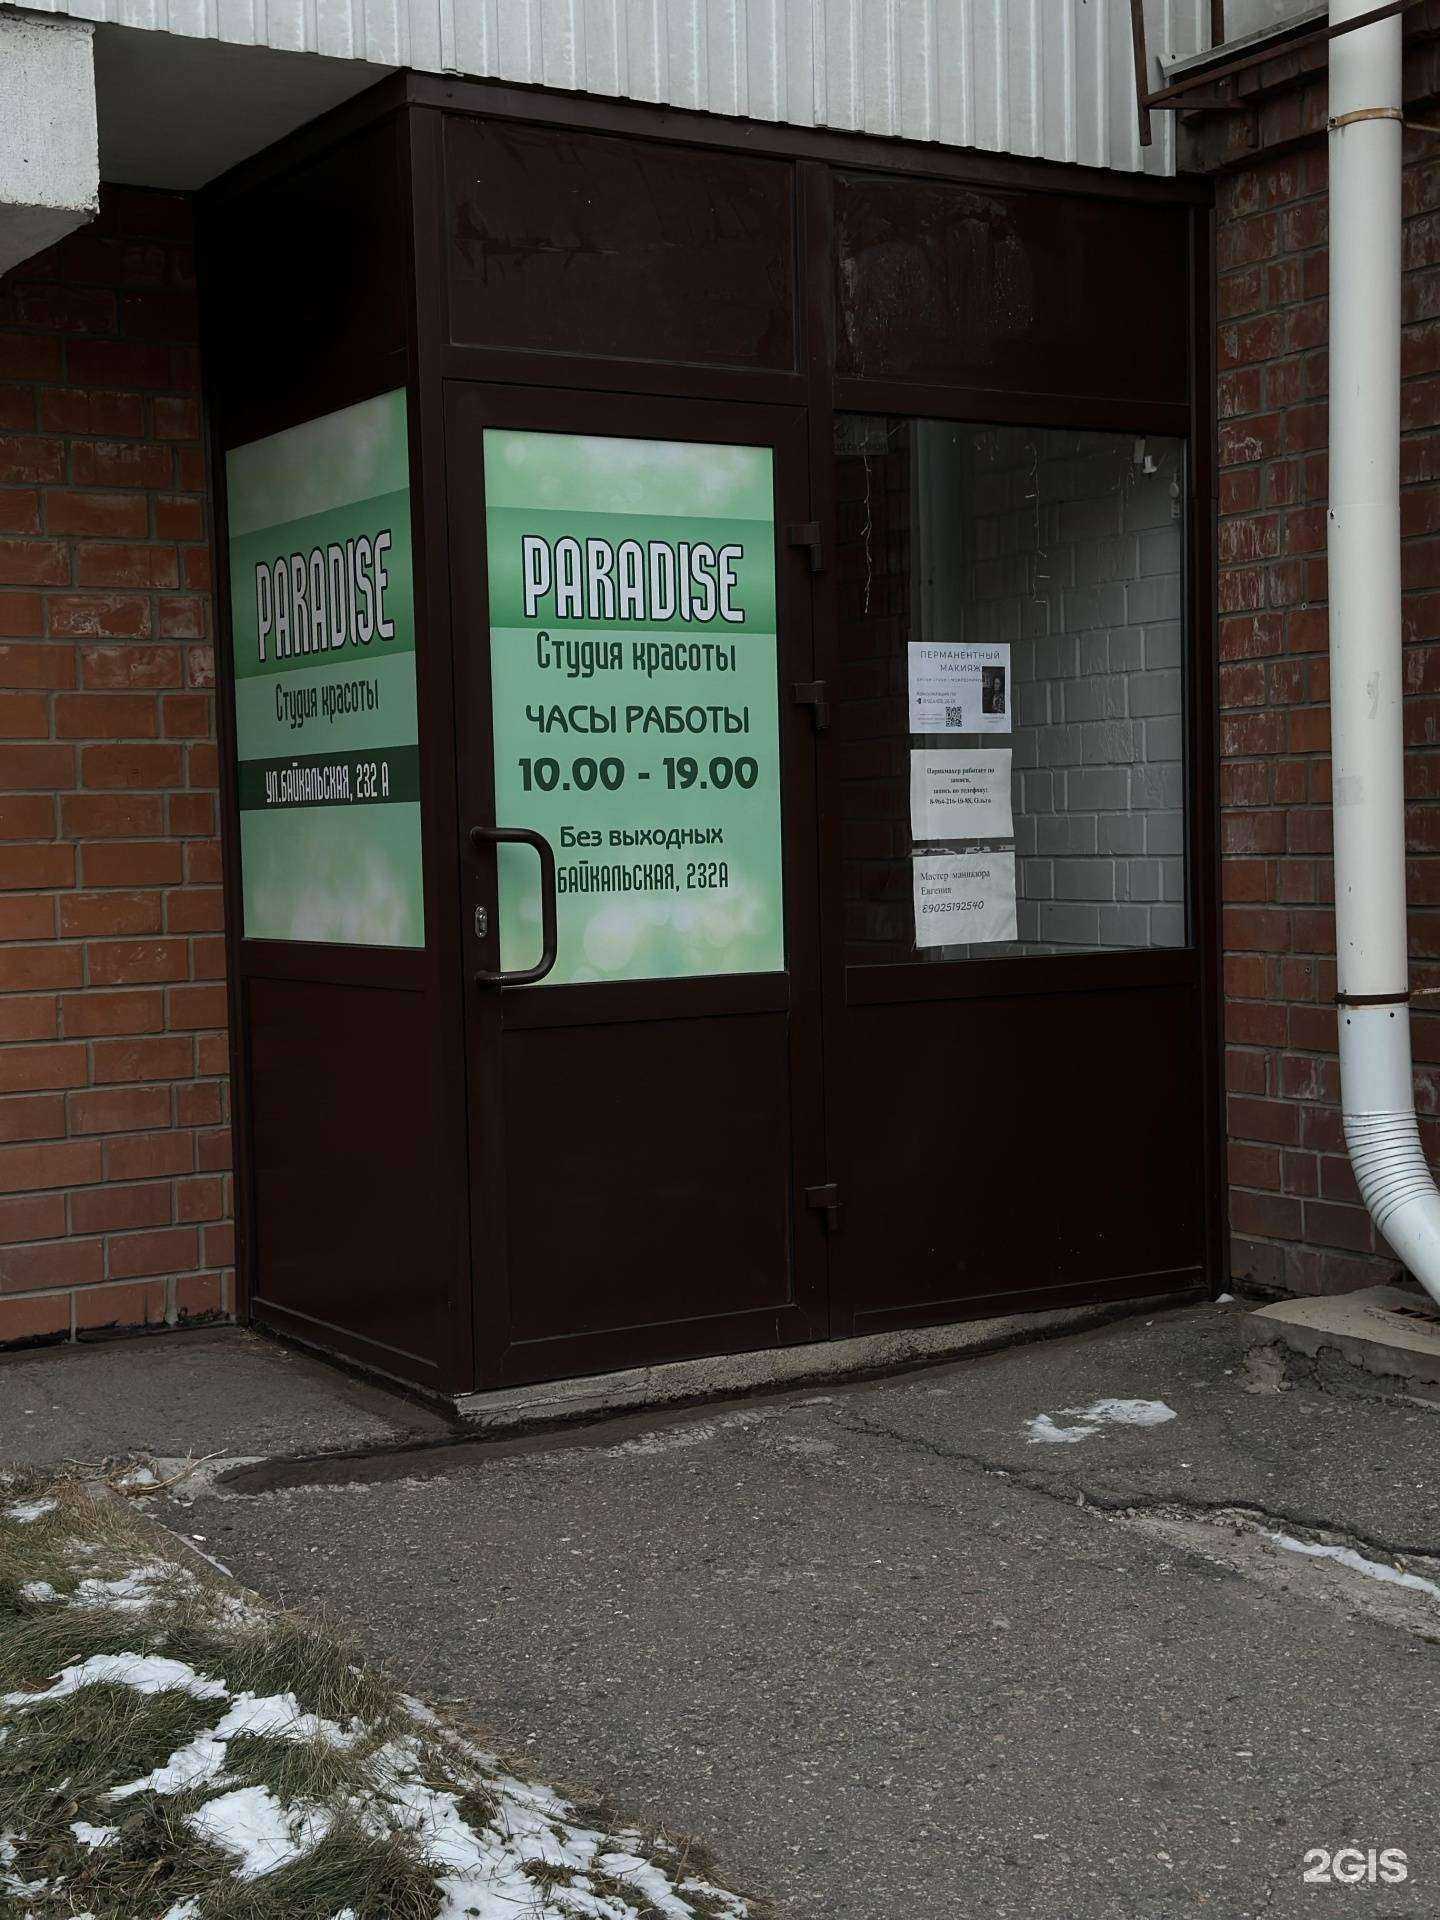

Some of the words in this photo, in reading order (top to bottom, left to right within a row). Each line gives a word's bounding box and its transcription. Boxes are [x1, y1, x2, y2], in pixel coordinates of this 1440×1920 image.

[521, 534, 746, 623] PARADISE
[254, 529, 395, 663] PARADISE
[536, 631, 622, 678] Студия
[632, 640, 736, 679] красоты
[920, 649, 1000, 660] ПЕРМАНЕНТНЫЙ
[940, 664, 982, 672] МАКИЯЖ
[275, 682, 318, 729] Студия
[320, 678, 379, 725] красоты
[525, 704, 617, 734] ЧАСЫ
[625, 705, 749, 734] РАБОТЫ
[356, 762, 377, 799] 232
[382, 761, 390, 797] А
[518, 756, 625, 791] 10.00
[662, 756, 759, 790] 19.00
[926, 768, 961, 776] Парикмахер
[962, 767, 986, 775] работает
[560, 825, 603, 848] Без
[609, 825, 723, 850] выходных
[686, 861, 729, 888] 232А
[920, 872, 949, 882] Мастер
[921, 887, 952, 896] Евгения
